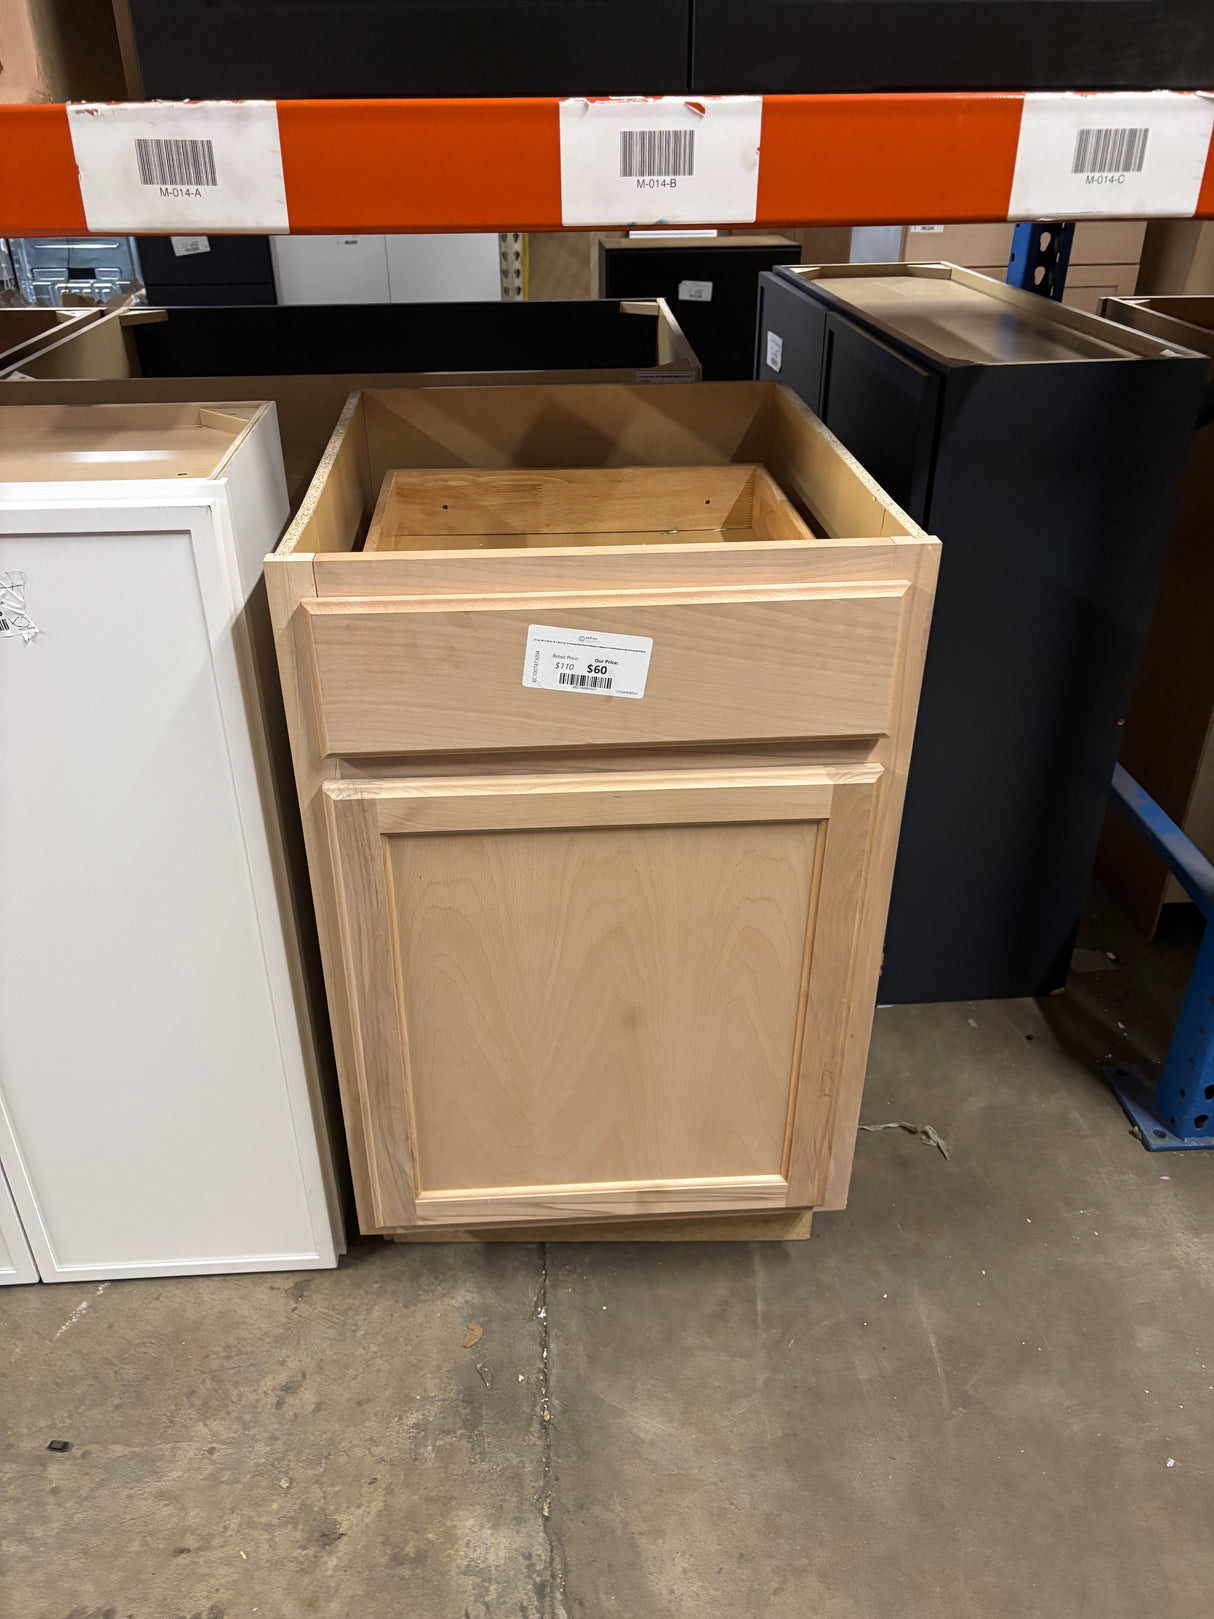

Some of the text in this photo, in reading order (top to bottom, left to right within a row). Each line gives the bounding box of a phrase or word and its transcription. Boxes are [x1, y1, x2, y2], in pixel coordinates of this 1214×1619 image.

[636, 178, 677, 188] M-014-B
[1085, 174, 1126, 184] M-014-C
[159, 187, 202, 197] M-014-A
[555, 662, 575, 671] $110
[586, 663, 608, 675] $60
